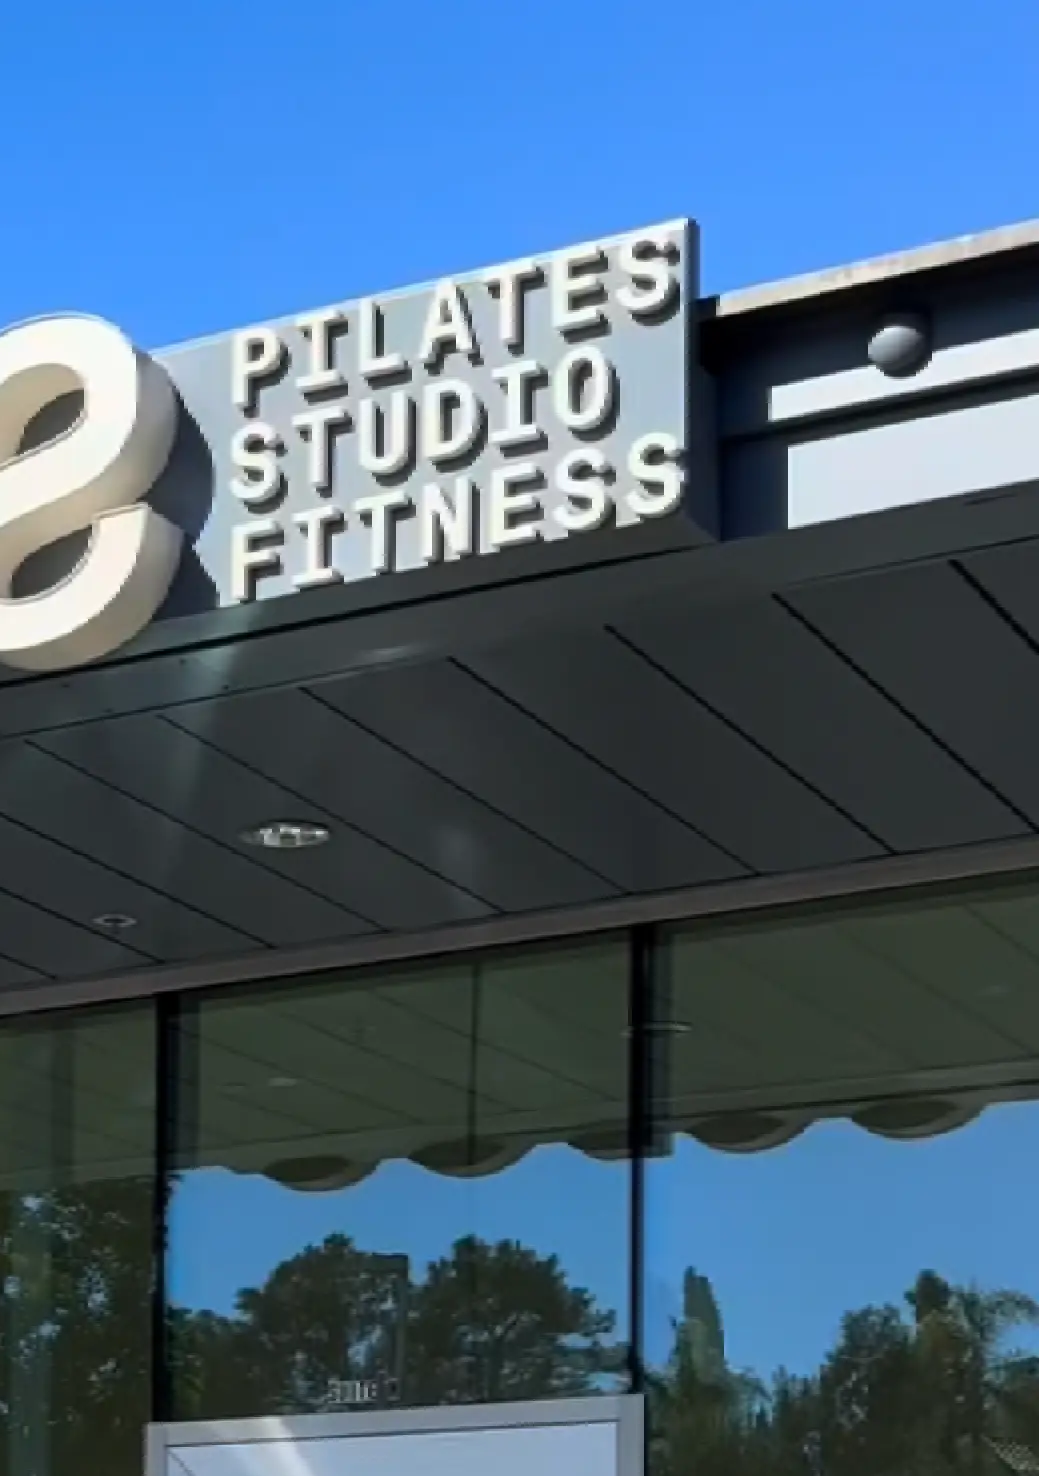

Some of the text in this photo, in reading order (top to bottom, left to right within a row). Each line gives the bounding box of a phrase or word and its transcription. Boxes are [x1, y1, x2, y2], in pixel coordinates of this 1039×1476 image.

[229, 234, 678, 412] PILATES
[228, 346, 618, 503] STUDIO
[228, 433, 686, 598] FITNESS
